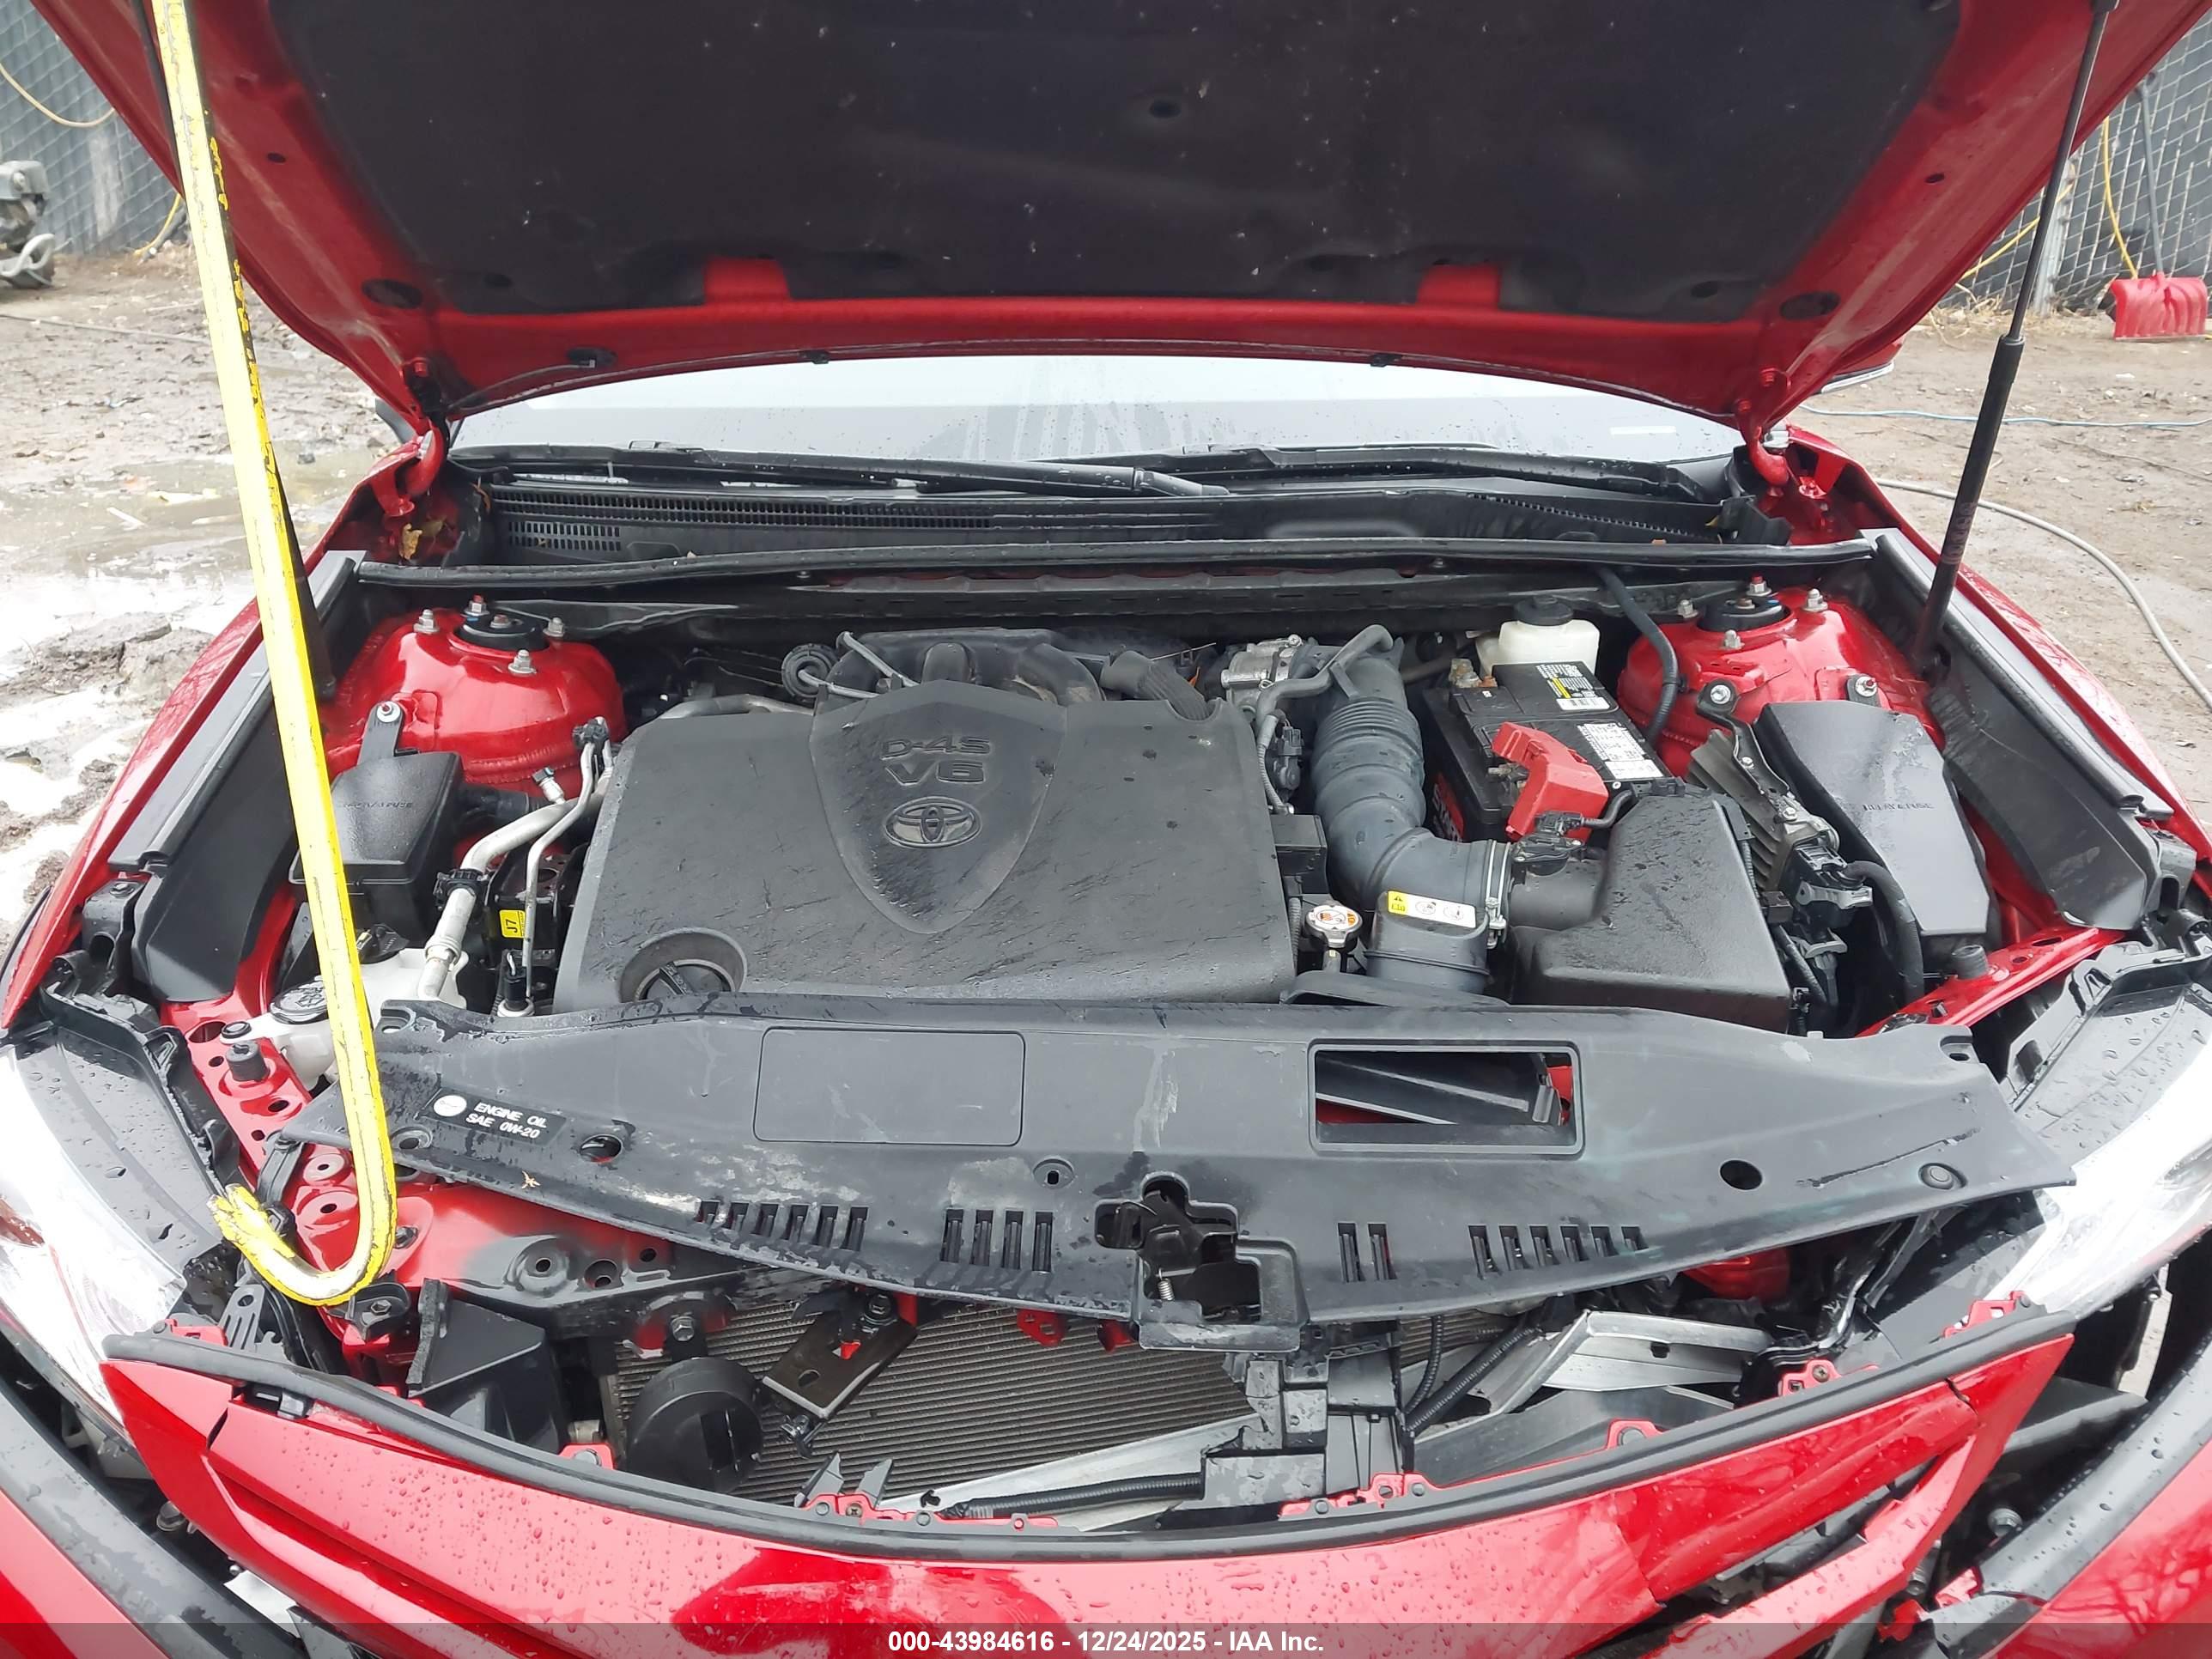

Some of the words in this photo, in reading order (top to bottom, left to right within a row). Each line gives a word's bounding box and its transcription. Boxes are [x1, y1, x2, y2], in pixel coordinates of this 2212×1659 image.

[884, 759, 987, 786] V6
[505, 918, 518, 933] J7
[465, 1113, 495, 1127] SAE
[499, 1121, 540, 1139] 0W-20
[473, 1102, 524, 1121] ENGINE
[526, 1115, 547, 1128] OIL
